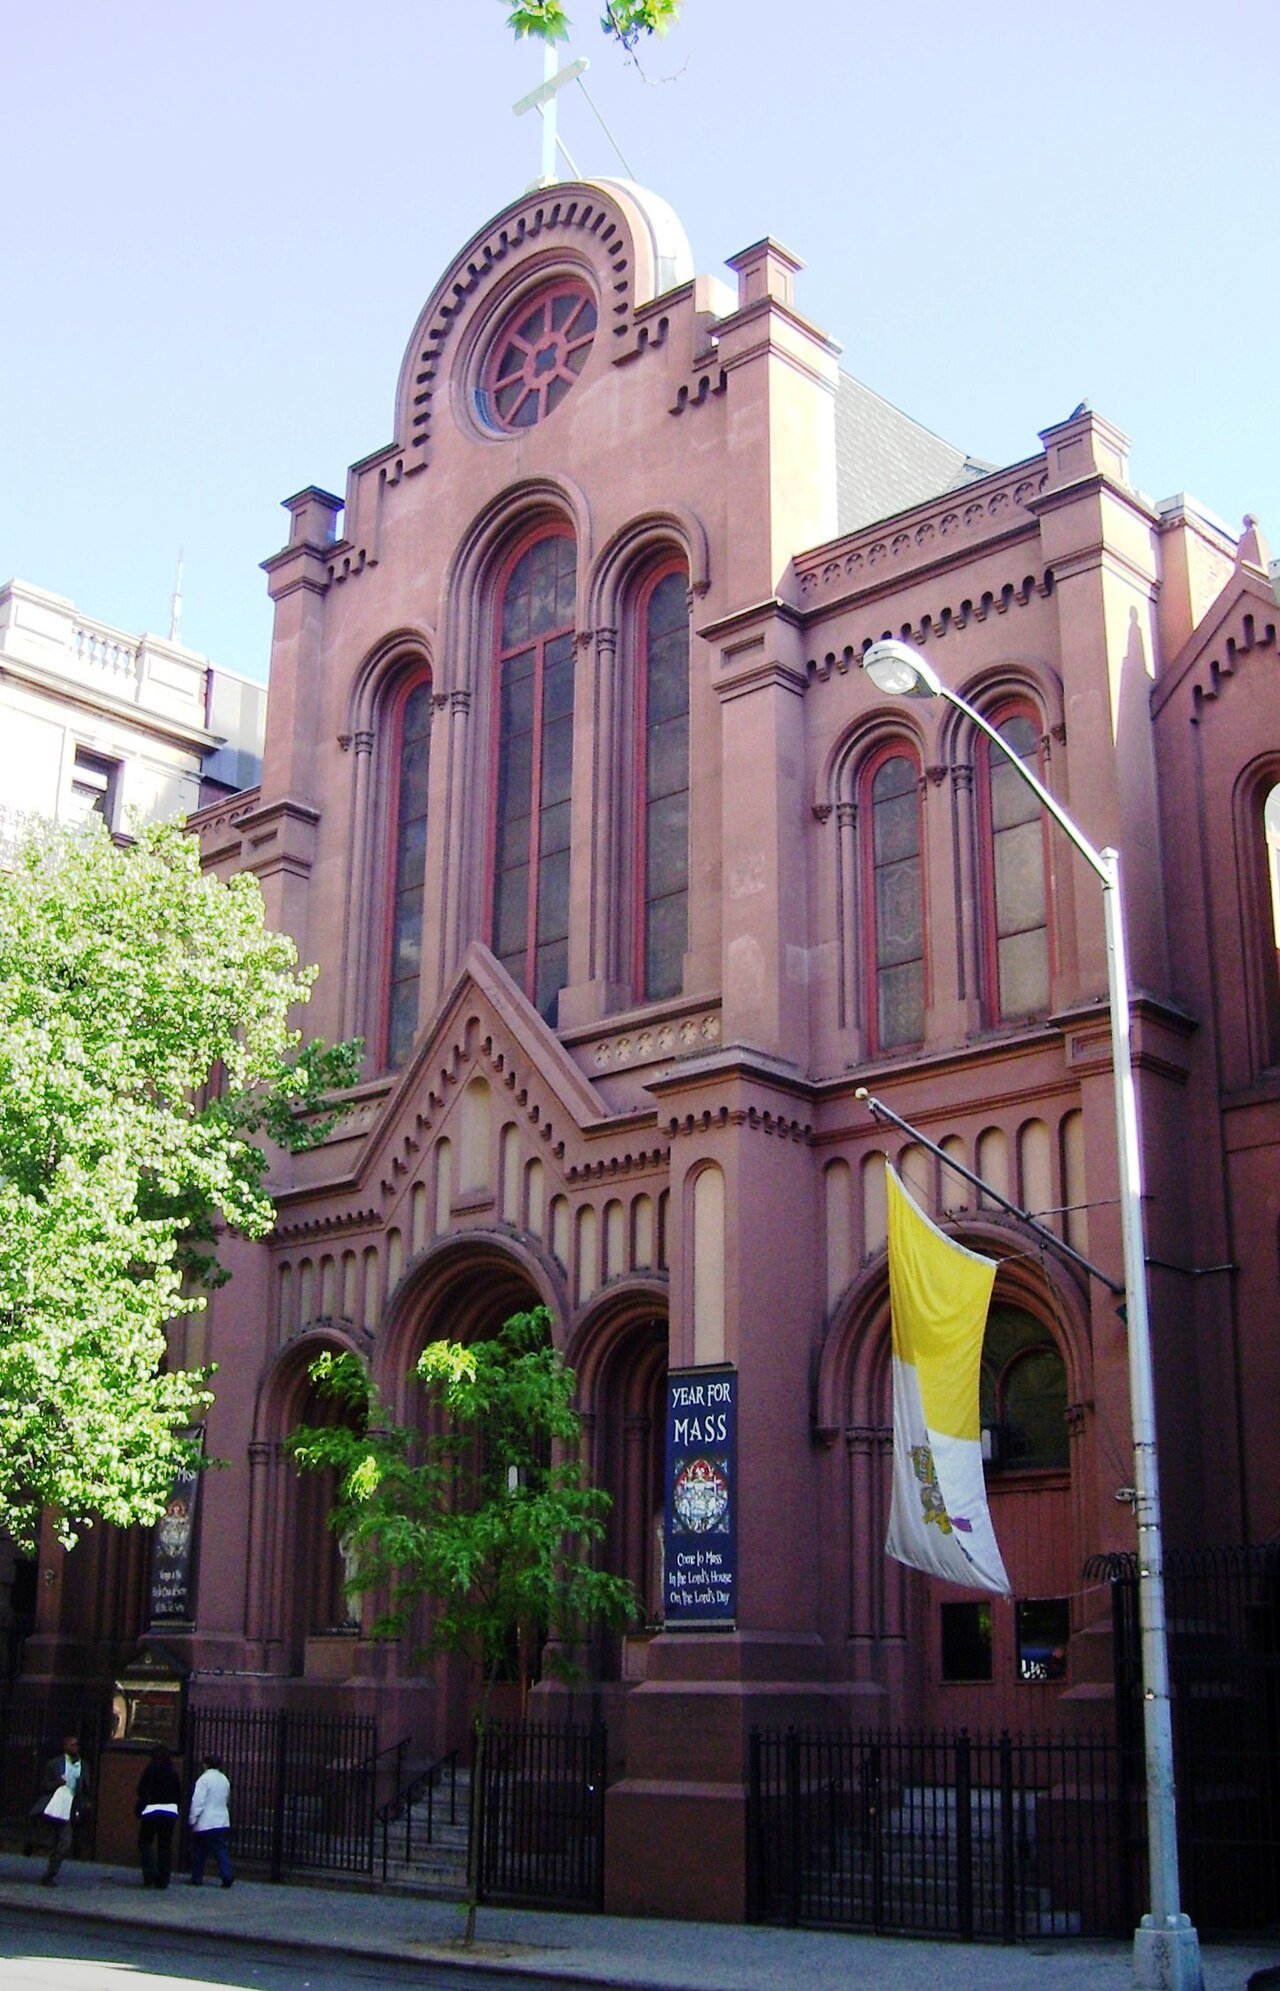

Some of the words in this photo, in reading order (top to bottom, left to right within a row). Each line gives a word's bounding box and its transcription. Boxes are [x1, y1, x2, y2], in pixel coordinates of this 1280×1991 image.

[672, 1386, 705, 1408] YEAR
[707, 1383, 732, 1406] FOR
[674, 1413, 727, 1446] MASS
[677, 1552, 696, 1566] Come
[705, 1551, 722, 1565] Mass
[688, 1568, 709, 1584] Lord's
[710, 1571, 732, 1584] House
[694, 1587, 716, 1604] Lord's
[716, 1590, 730, 1605] Day
